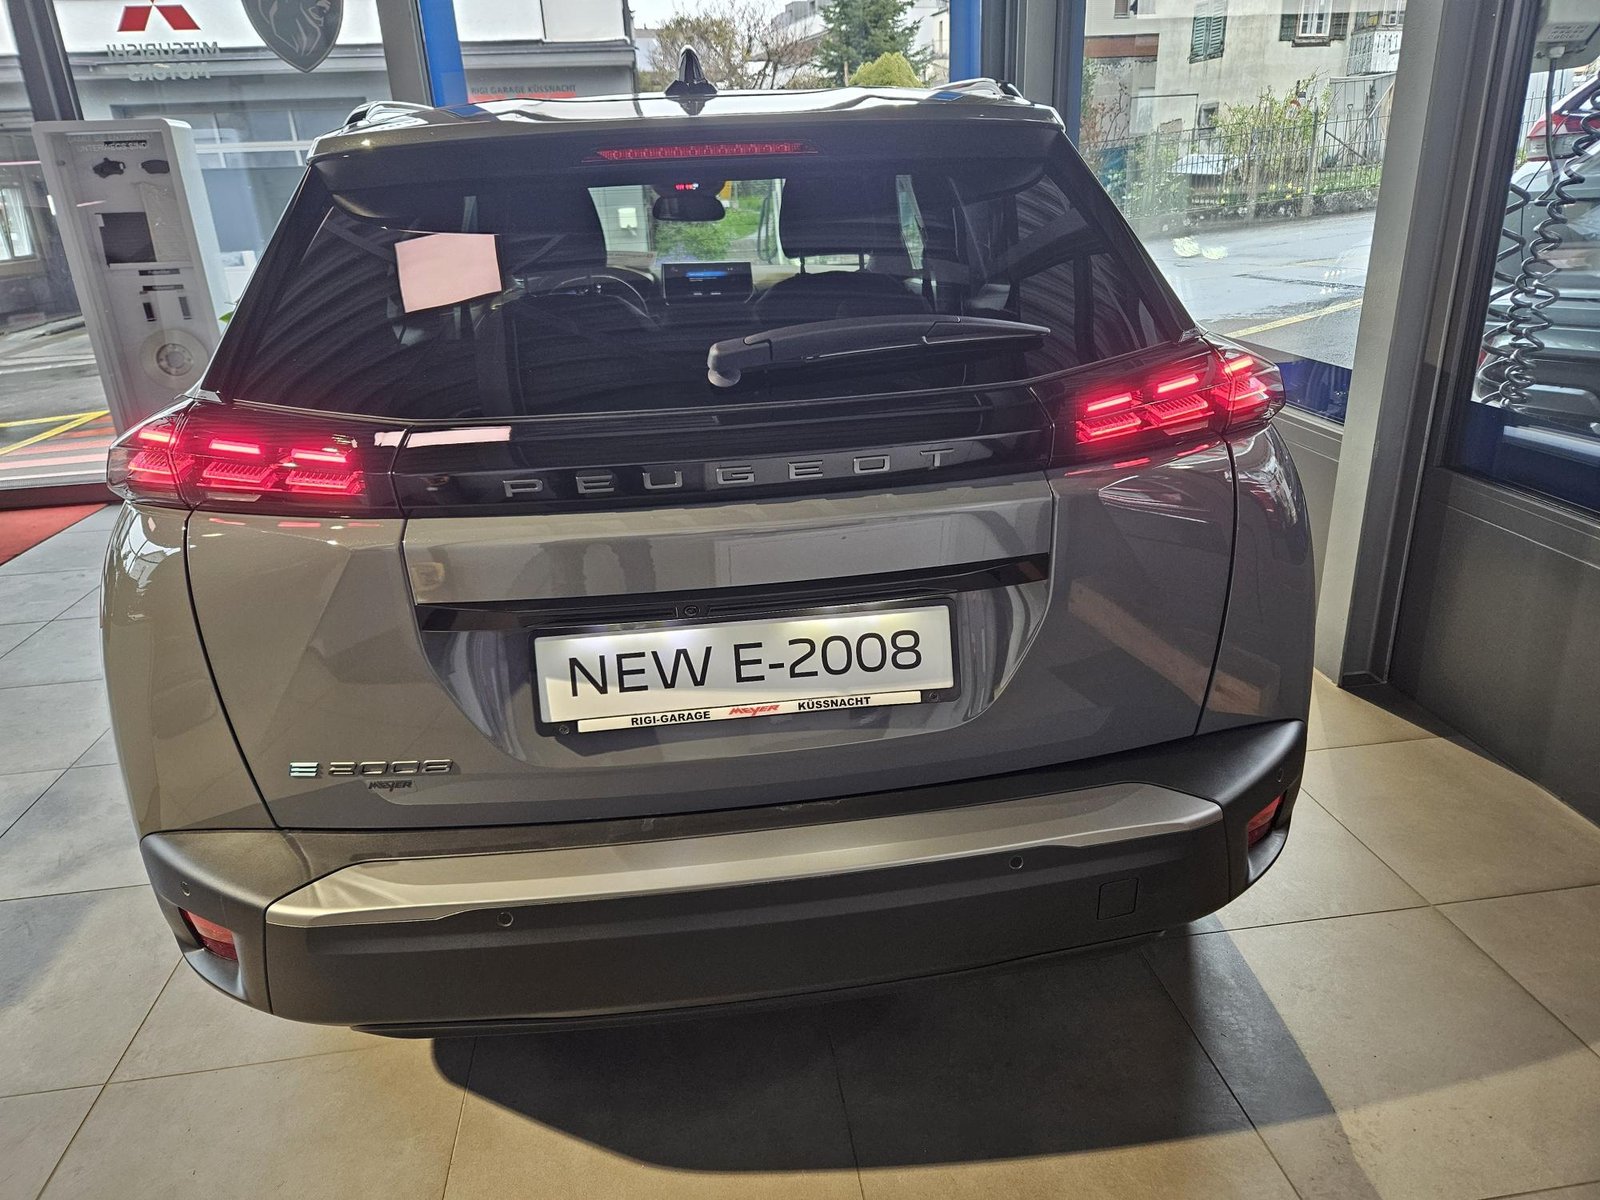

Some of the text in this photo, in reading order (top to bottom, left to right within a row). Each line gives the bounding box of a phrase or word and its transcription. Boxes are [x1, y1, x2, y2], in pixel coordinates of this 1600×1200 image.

[502, 447, 955, 498] PEUGEOT
[568, 629, 923, 698] NEW E-2008
[630, 695, 871, 727] RIGI-GARAGE MEYER KÜSSNACHT
[327, 758, 453, 777] 2008
